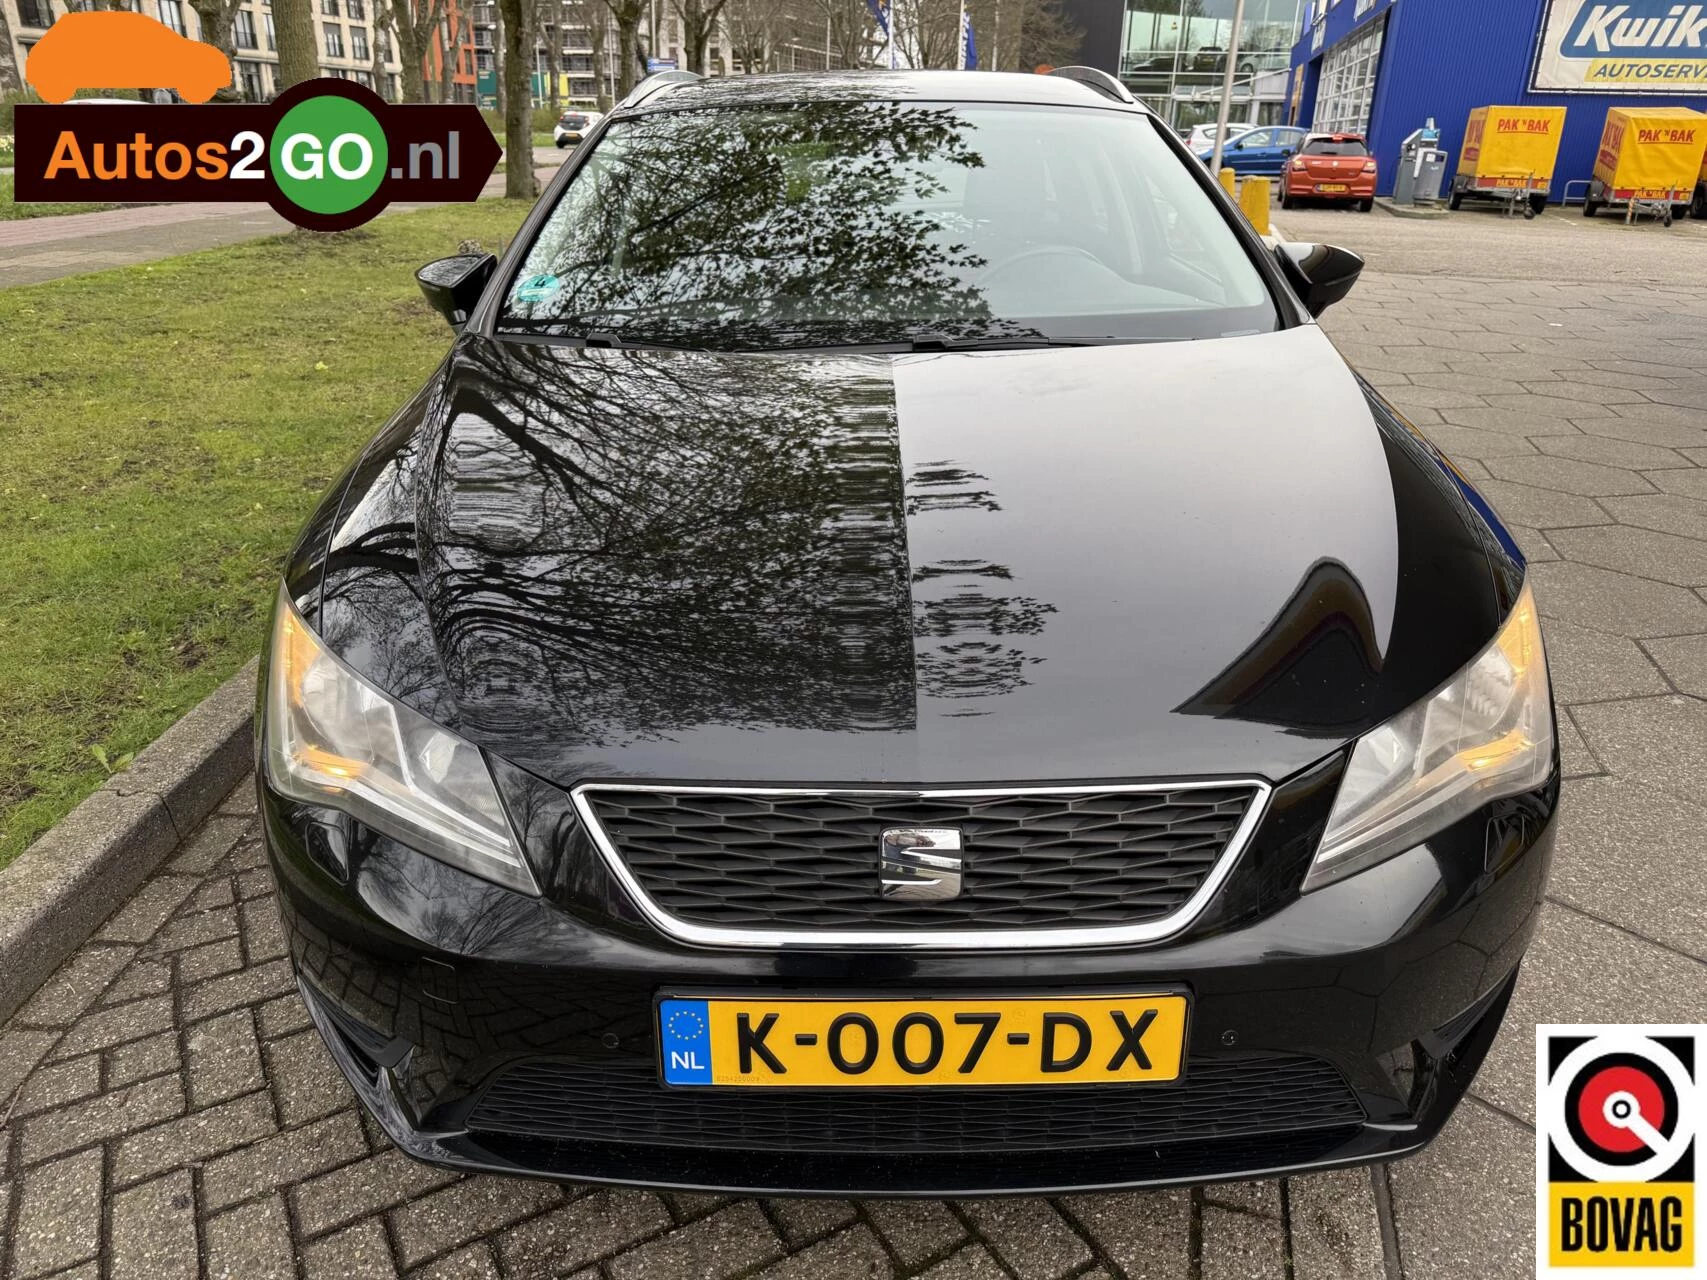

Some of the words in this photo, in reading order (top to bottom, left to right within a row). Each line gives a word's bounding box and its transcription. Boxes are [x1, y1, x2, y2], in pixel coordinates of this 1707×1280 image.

[1594, 63, 1707, 78] AUTOSERV
[1498, 118, 1519, 131] PAK
[1527, 119, 1551, 132] BAK
[1638, 129, 1662, 142] PAK
[1670, 130, 1696, 142] BAK
[735, 1009, 1159, 1074] K-007-DX
[671, 1051, 705, 1070] NL
